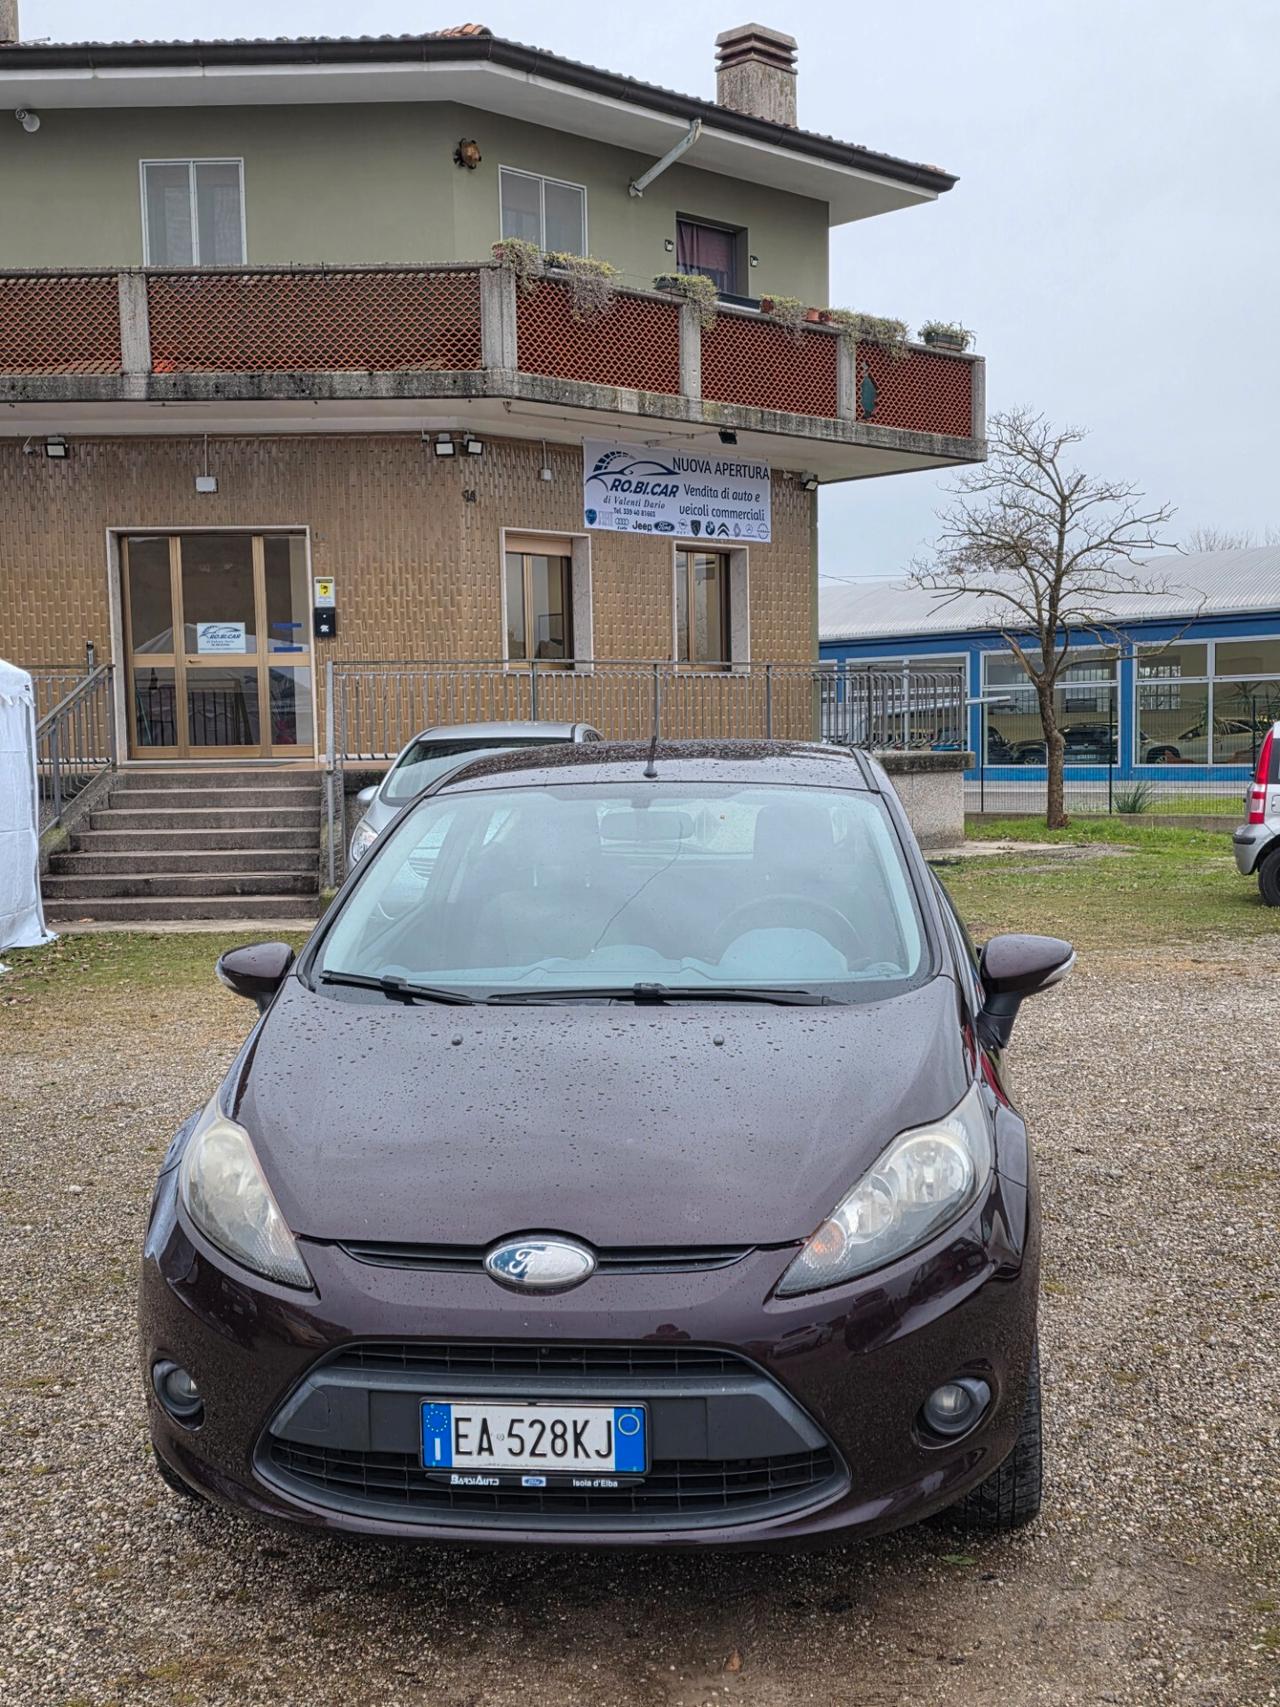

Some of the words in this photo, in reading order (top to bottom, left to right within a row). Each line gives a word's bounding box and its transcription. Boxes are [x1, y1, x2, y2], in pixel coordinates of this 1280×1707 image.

[673, 457, 712, 474] NUOVA
[714, 462, 770, 480] APERTURA
[609, 478, 679, 498] RO.BI.CAR
[684, 484, 719, 499] Vendita
[721, 488, 730, 501] di
[732, 490, 753, 502] auto
[755, 493, 761, 503] e
[603, 495, 611, 504] di
[614, 496, 641, 507] Valenti
[643, 499, 666, 509] Dario
[680, 503, 709, 517] veicoli
[711, 508, 765, 521] commerciali
[632, 520, 653, 532] Jeep
[573, 1479, 592, 1487] Isola
[593, 1479, 618, 1488] d'Elba
